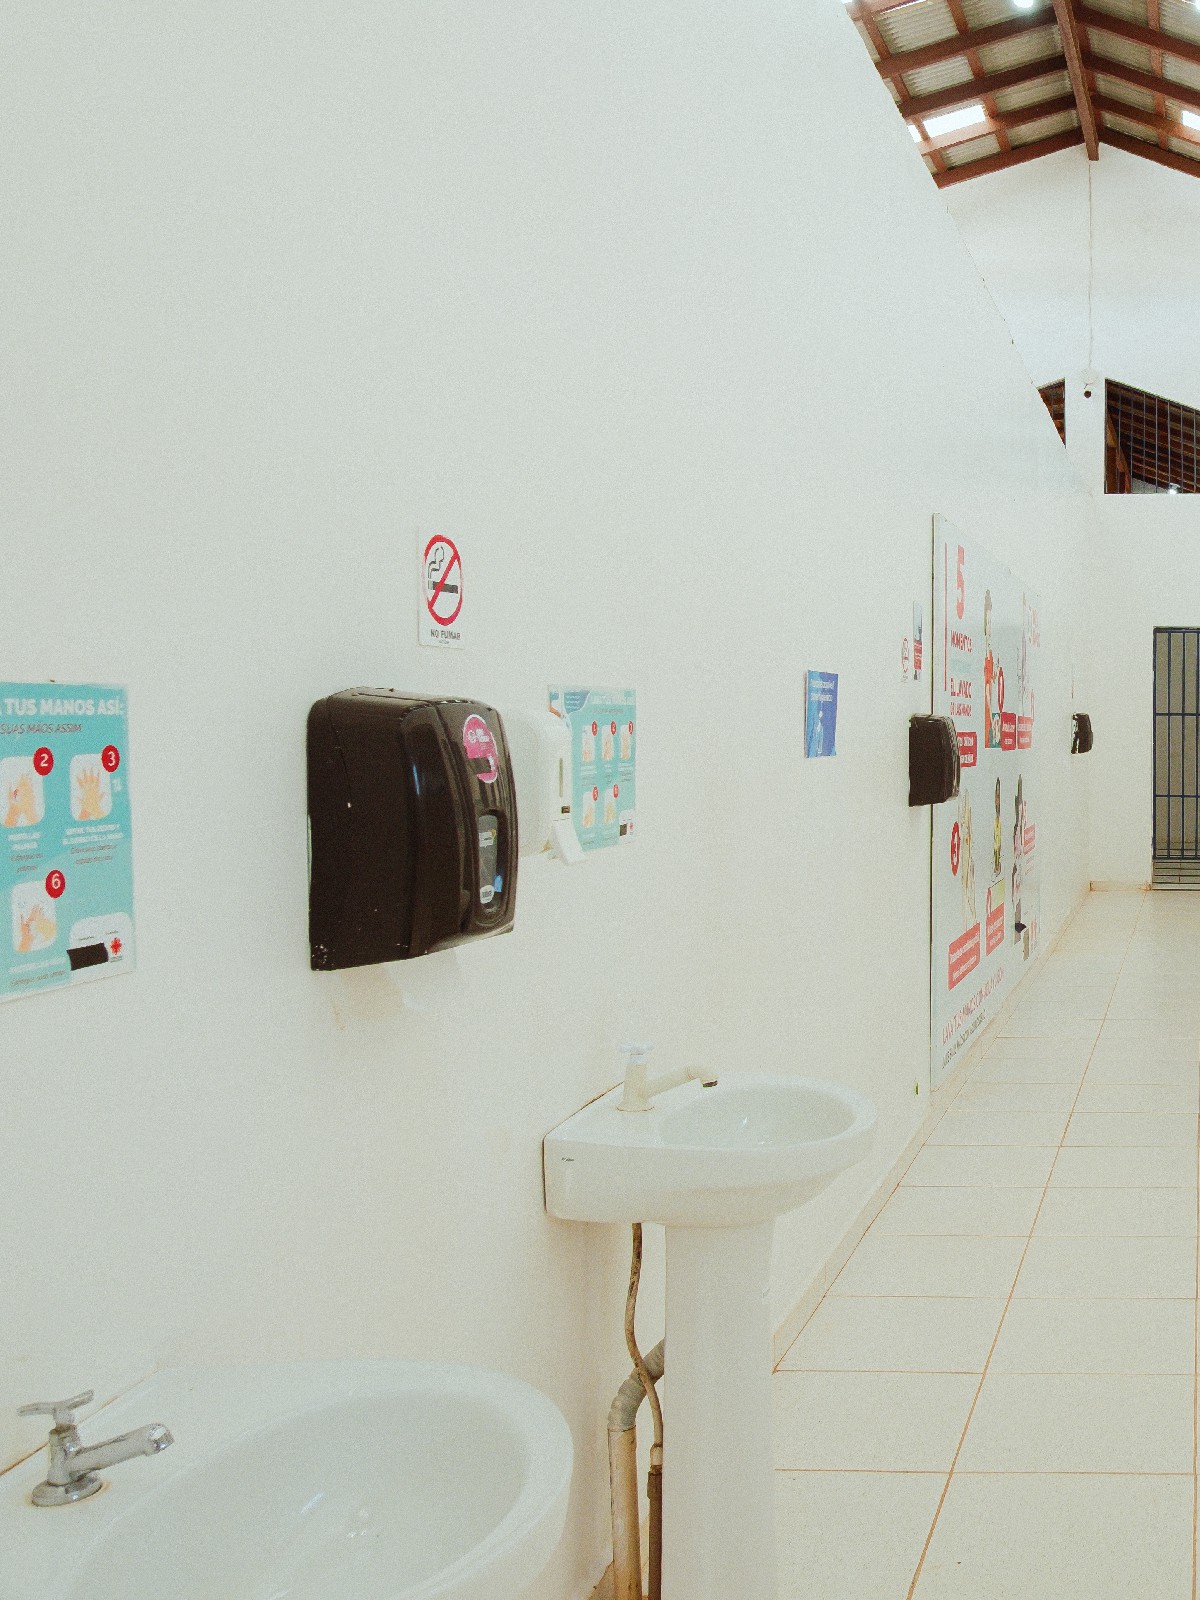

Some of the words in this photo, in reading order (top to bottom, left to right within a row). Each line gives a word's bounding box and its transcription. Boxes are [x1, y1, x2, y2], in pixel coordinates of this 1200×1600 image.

[956, 545, 965, 620] 5
[430, 629, 439, 639] NO
[440, 630, 461, 640] FUMAR
[4, 698, 37, 716] TUS
[40, 698, 95, 716] MANOS
[40, 753, 49, 767] 2
[107, 751, 116, 767] 3
[51, 873, 61, 890] 6
